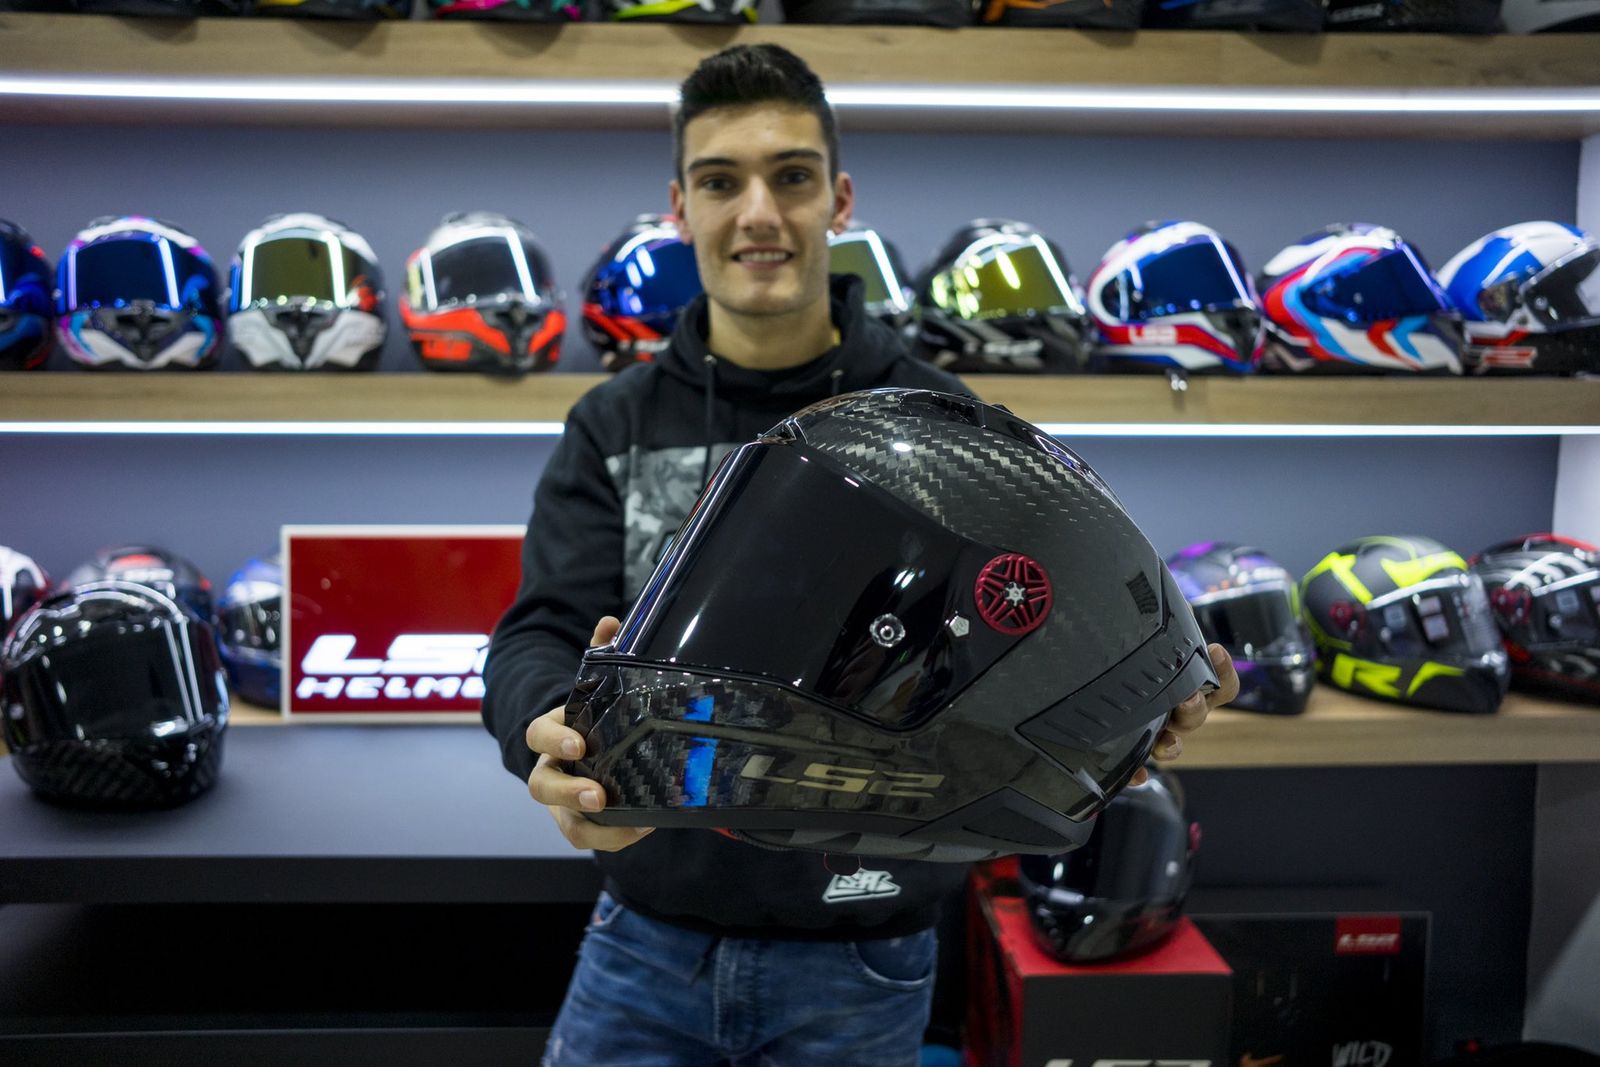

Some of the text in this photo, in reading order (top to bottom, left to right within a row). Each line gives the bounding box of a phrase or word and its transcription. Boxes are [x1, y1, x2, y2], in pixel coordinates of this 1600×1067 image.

[300, 633, 490, 675] LS
[739, 753, 945, 798] LS2
[1331, 1039, 1393, 1067] WILD
